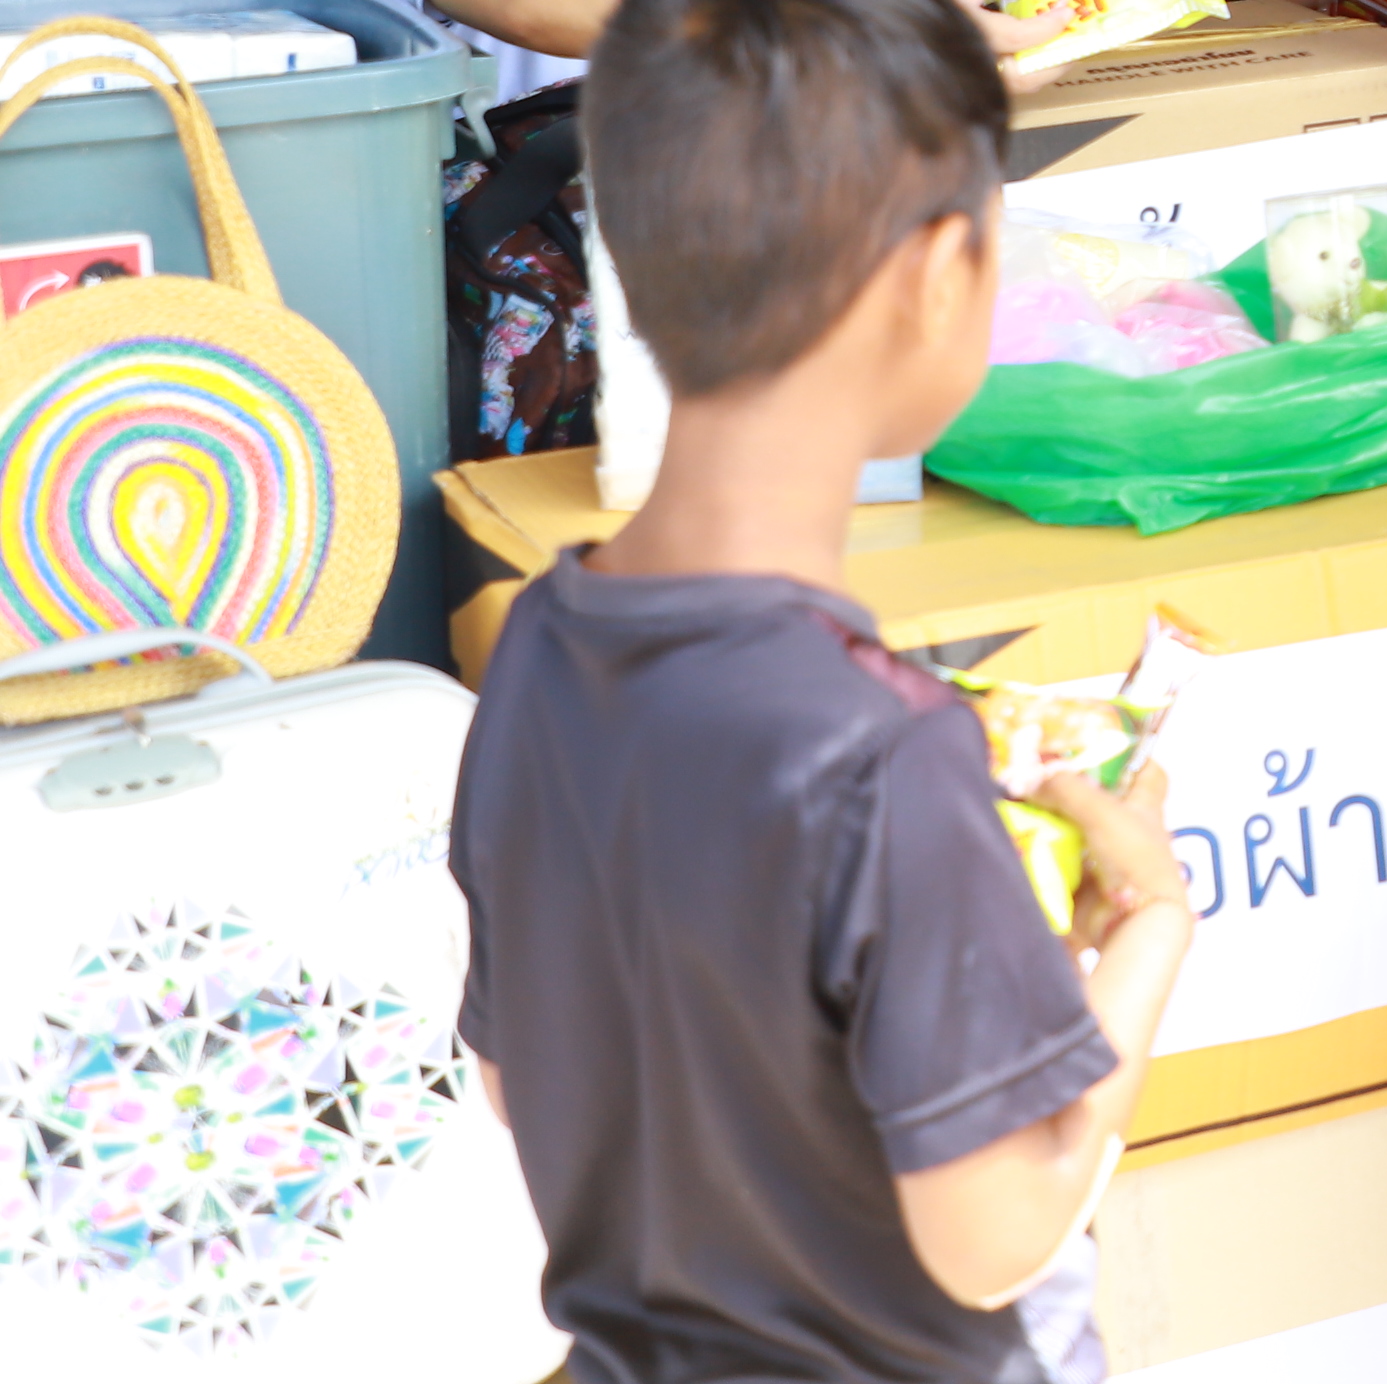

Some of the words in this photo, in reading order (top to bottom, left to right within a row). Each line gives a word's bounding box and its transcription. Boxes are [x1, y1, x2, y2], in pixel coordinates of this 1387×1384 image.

[1053, 68, 1166, 89] HANDLE
[1169, 59, 1240, 75] WITH
[1245, 49, 1314, 64] CARE
